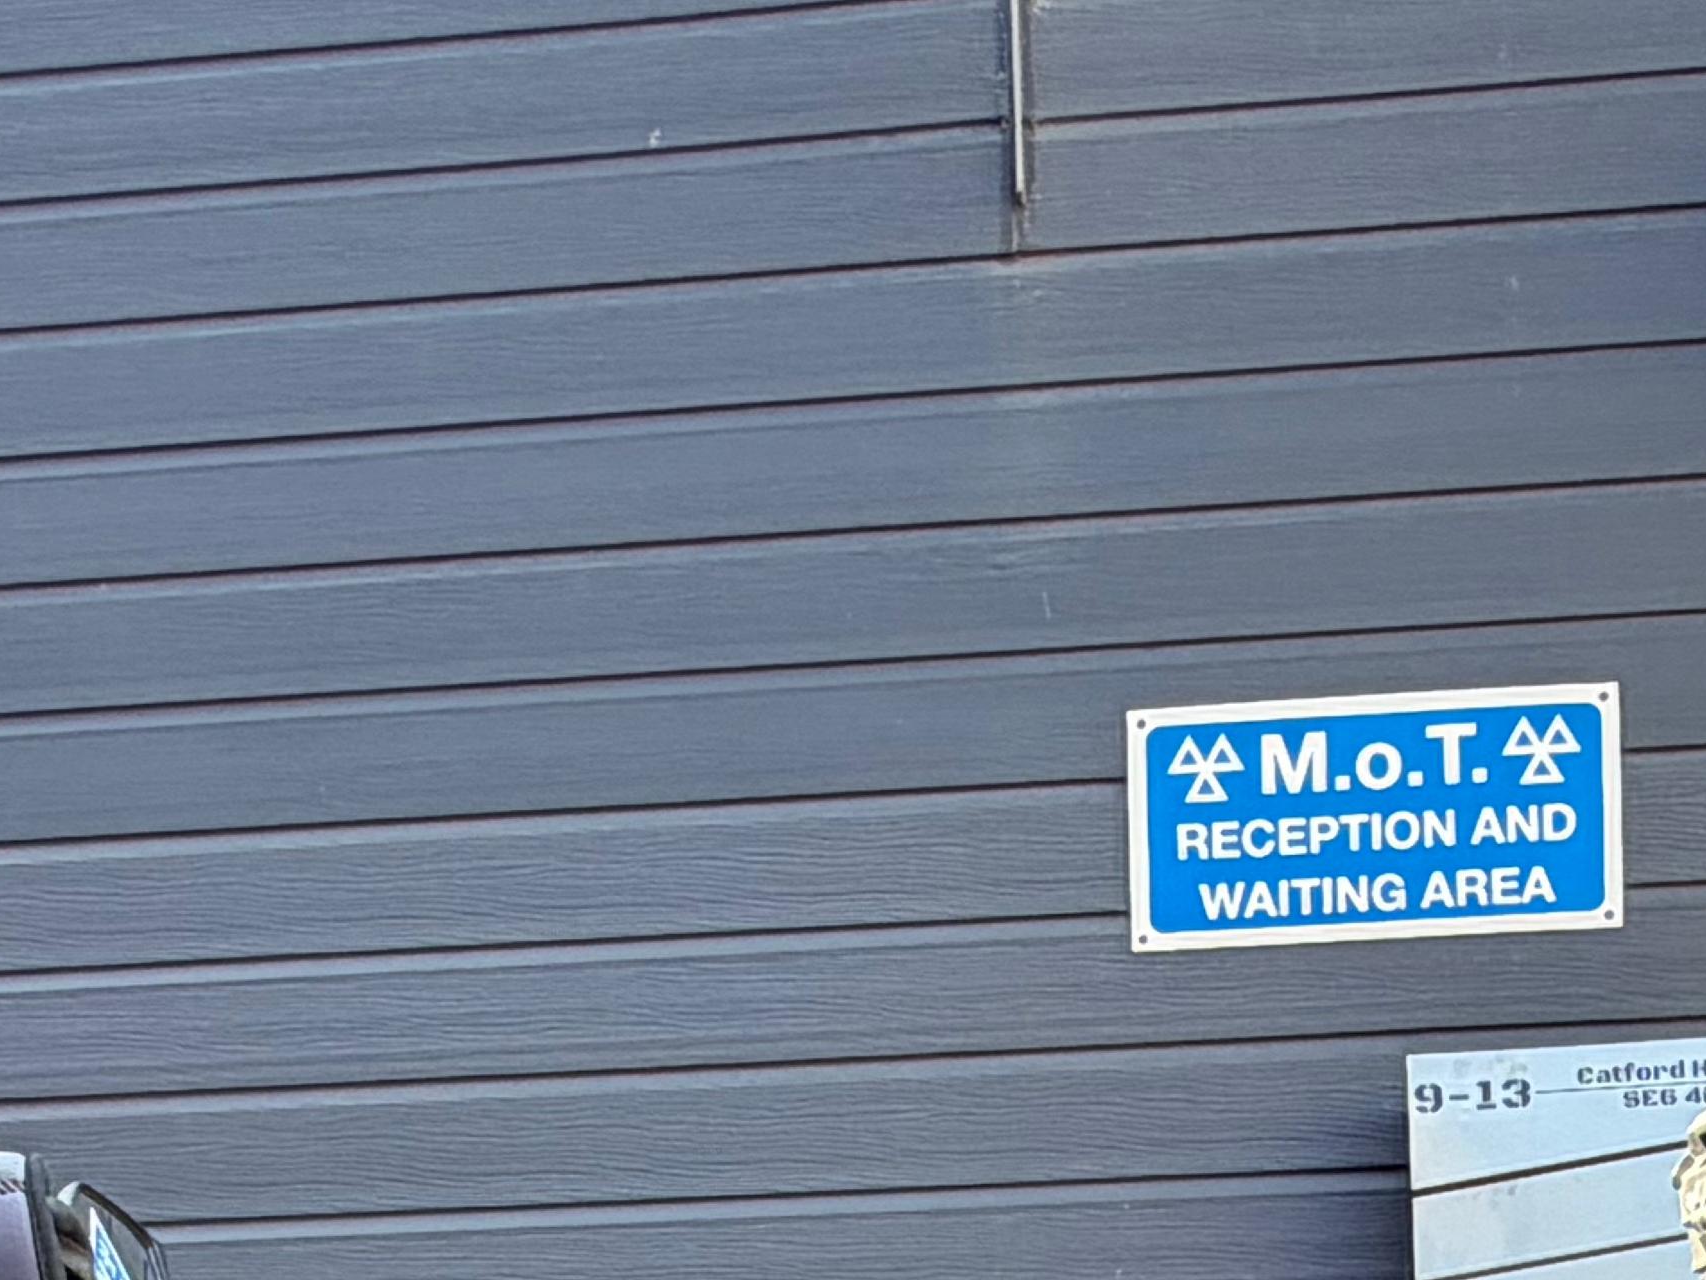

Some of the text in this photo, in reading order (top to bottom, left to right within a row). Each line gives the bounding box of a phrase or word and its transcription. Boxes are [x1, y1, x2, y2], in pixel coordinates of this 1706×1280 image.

[1260, 722, 1489, 796] M.o.T.
[1176, 802, 1578, 861] RECEPTION AND
[1198, 866, 1557, 921] WAITING AREA
[1577, 1060, 1685, 1085] Catford
[1414, 1079, 1531, 1113] 9-13
[1623, 1088, 1678, 1108] SE6
